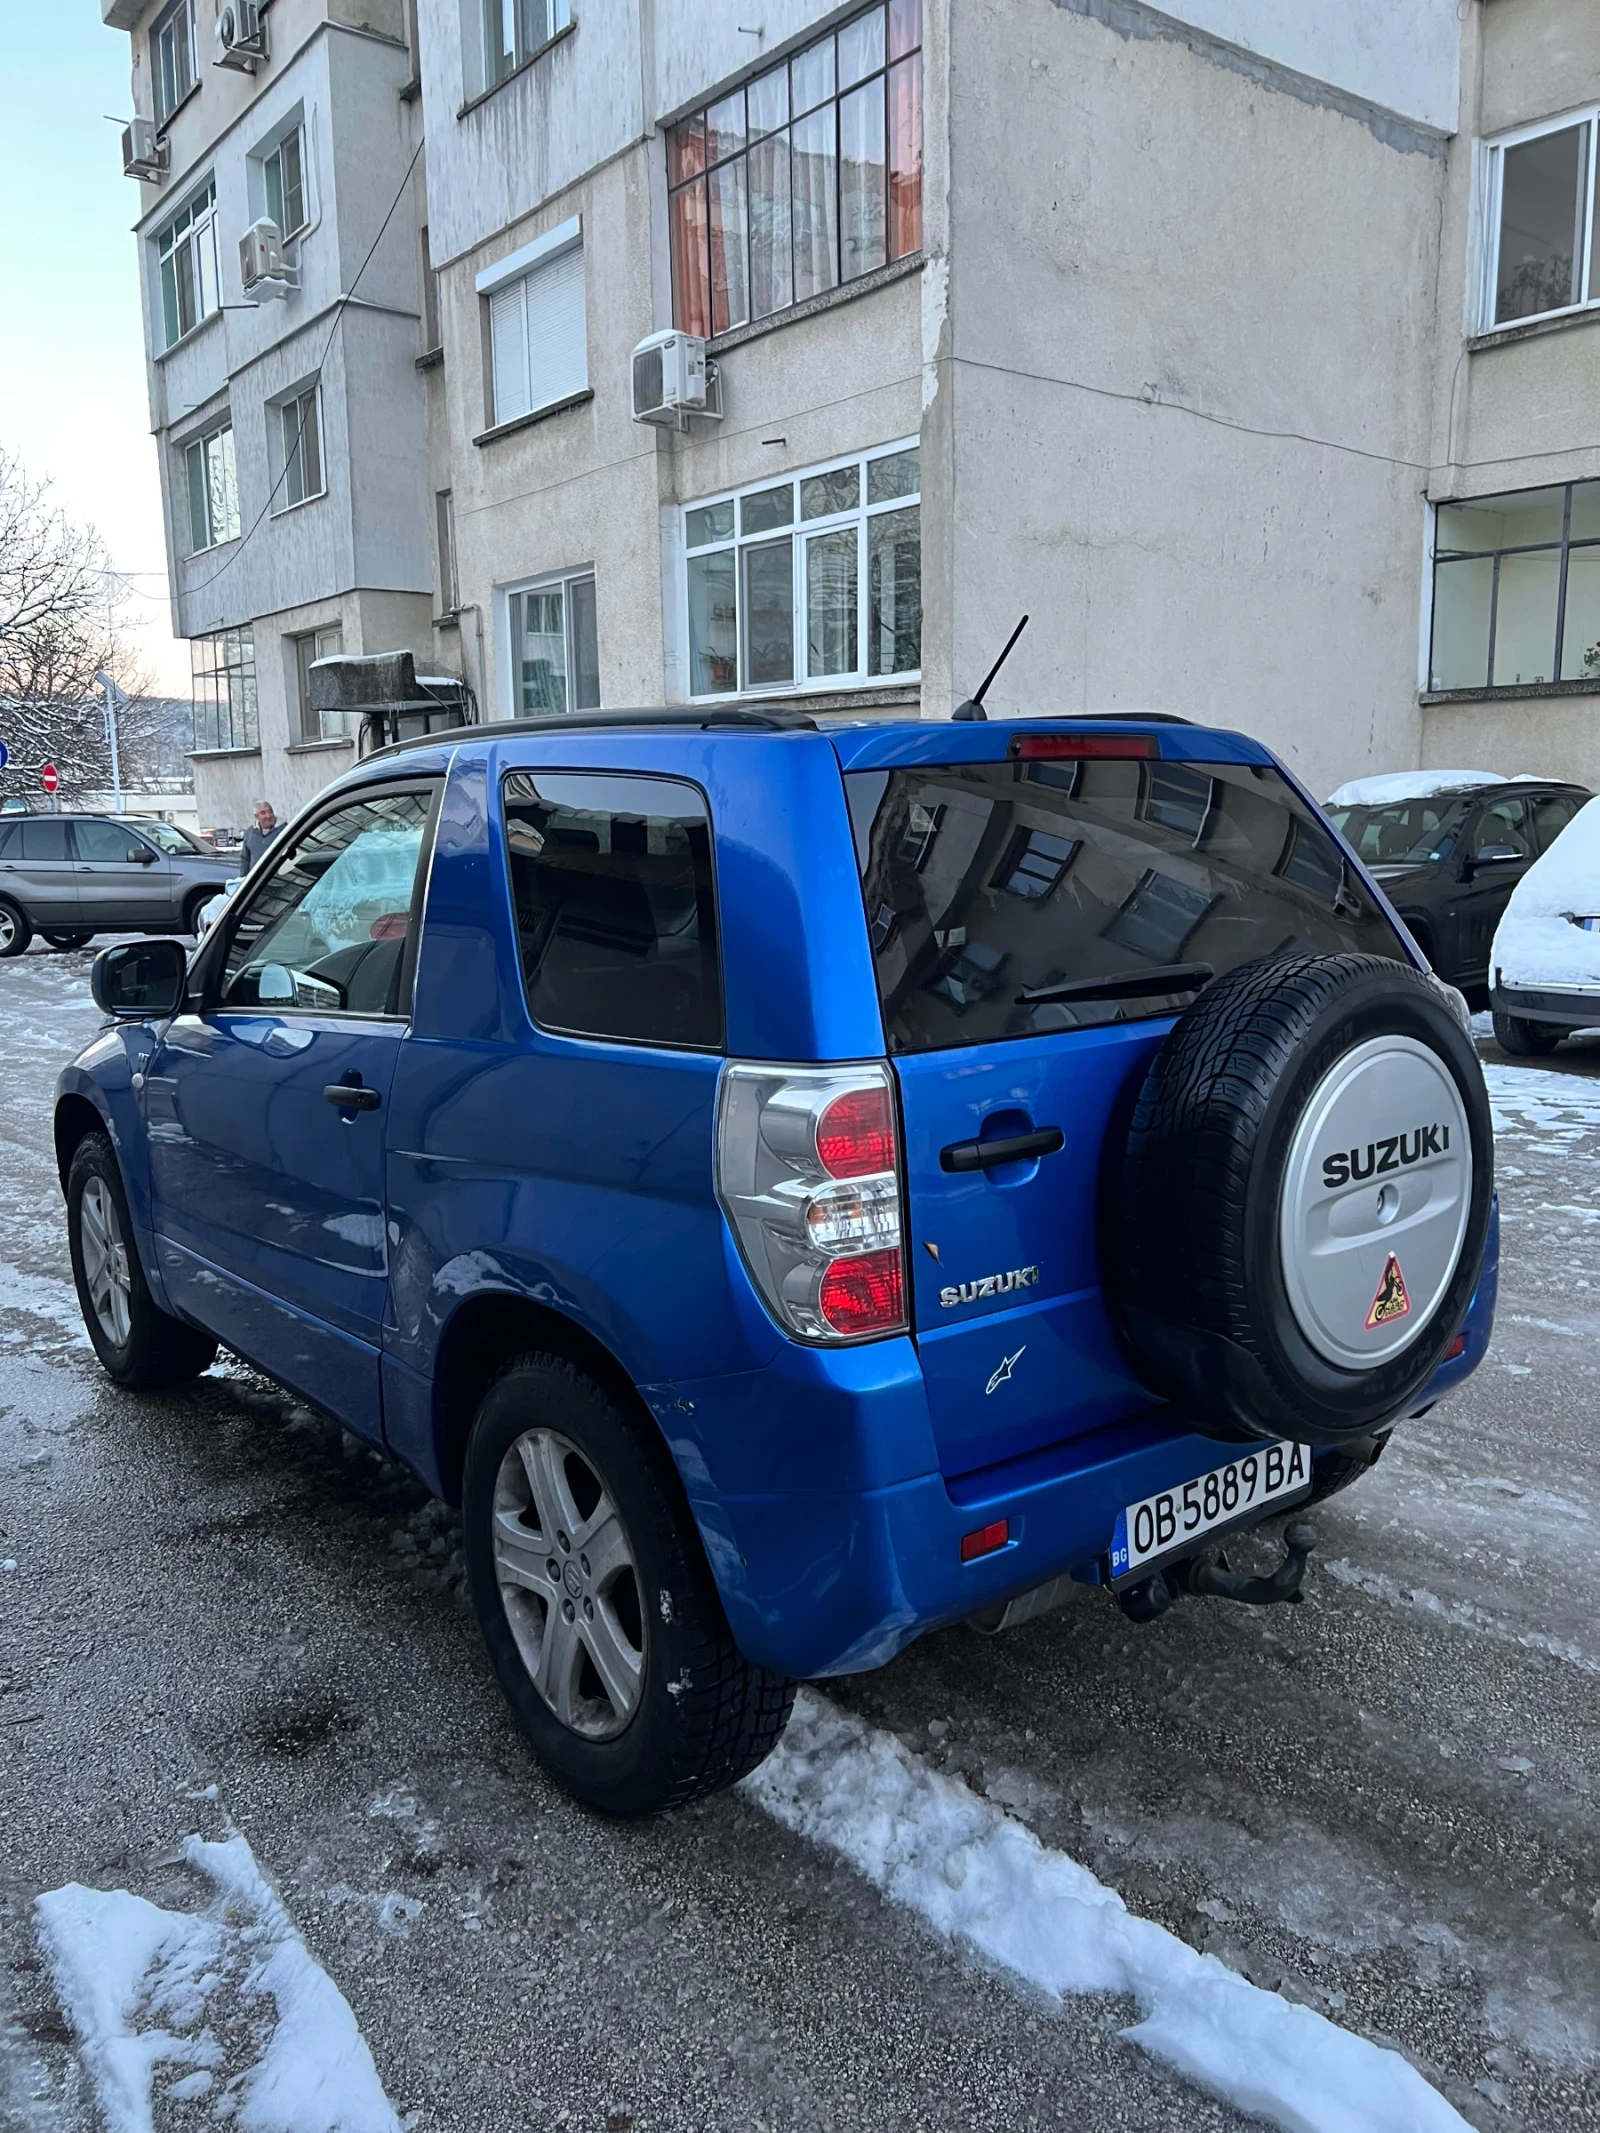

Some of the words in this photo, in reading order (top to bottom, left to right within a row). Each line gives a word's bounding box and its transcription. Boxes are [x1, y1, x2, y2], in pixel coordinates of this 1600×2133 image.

[1322, 1122, 1450, 1189] SUZUKI
[939, 1265, 1040, 1308] SUZUKI
[1112, 1548, 1127, 1567] BG
